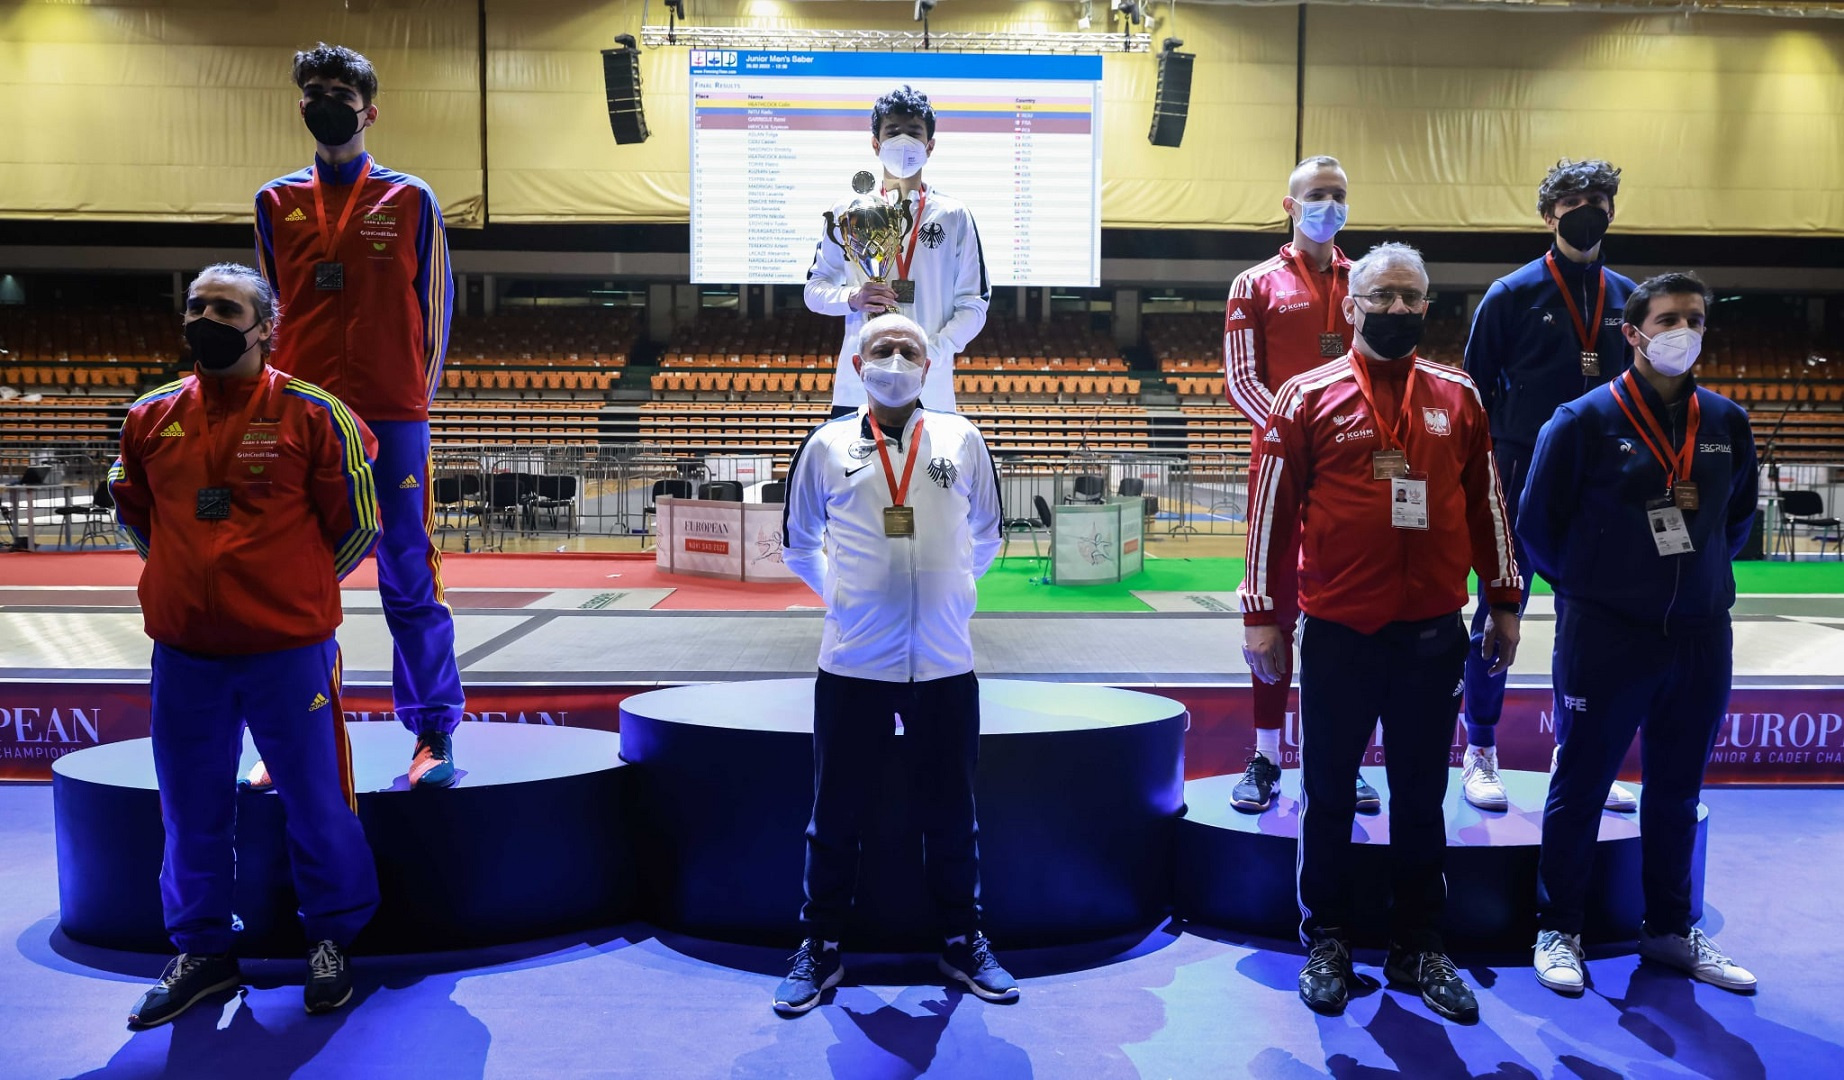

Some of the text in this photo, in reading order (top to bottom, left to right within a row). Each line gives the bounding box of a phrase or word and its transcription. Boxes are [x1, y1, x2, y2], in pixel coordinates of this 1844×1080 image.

[1347, 429, 1374, 438] KGHM
[685, 520, 728, 533] EUROPEAN
[309, 699, 329, 711] adidas
[1564, 696, 1586, 711] FFE
[1753, 752, 1760, 762] &
[1768, 752, 1810, 763] CADET
[1816, 752, 1844, 763] CHA
